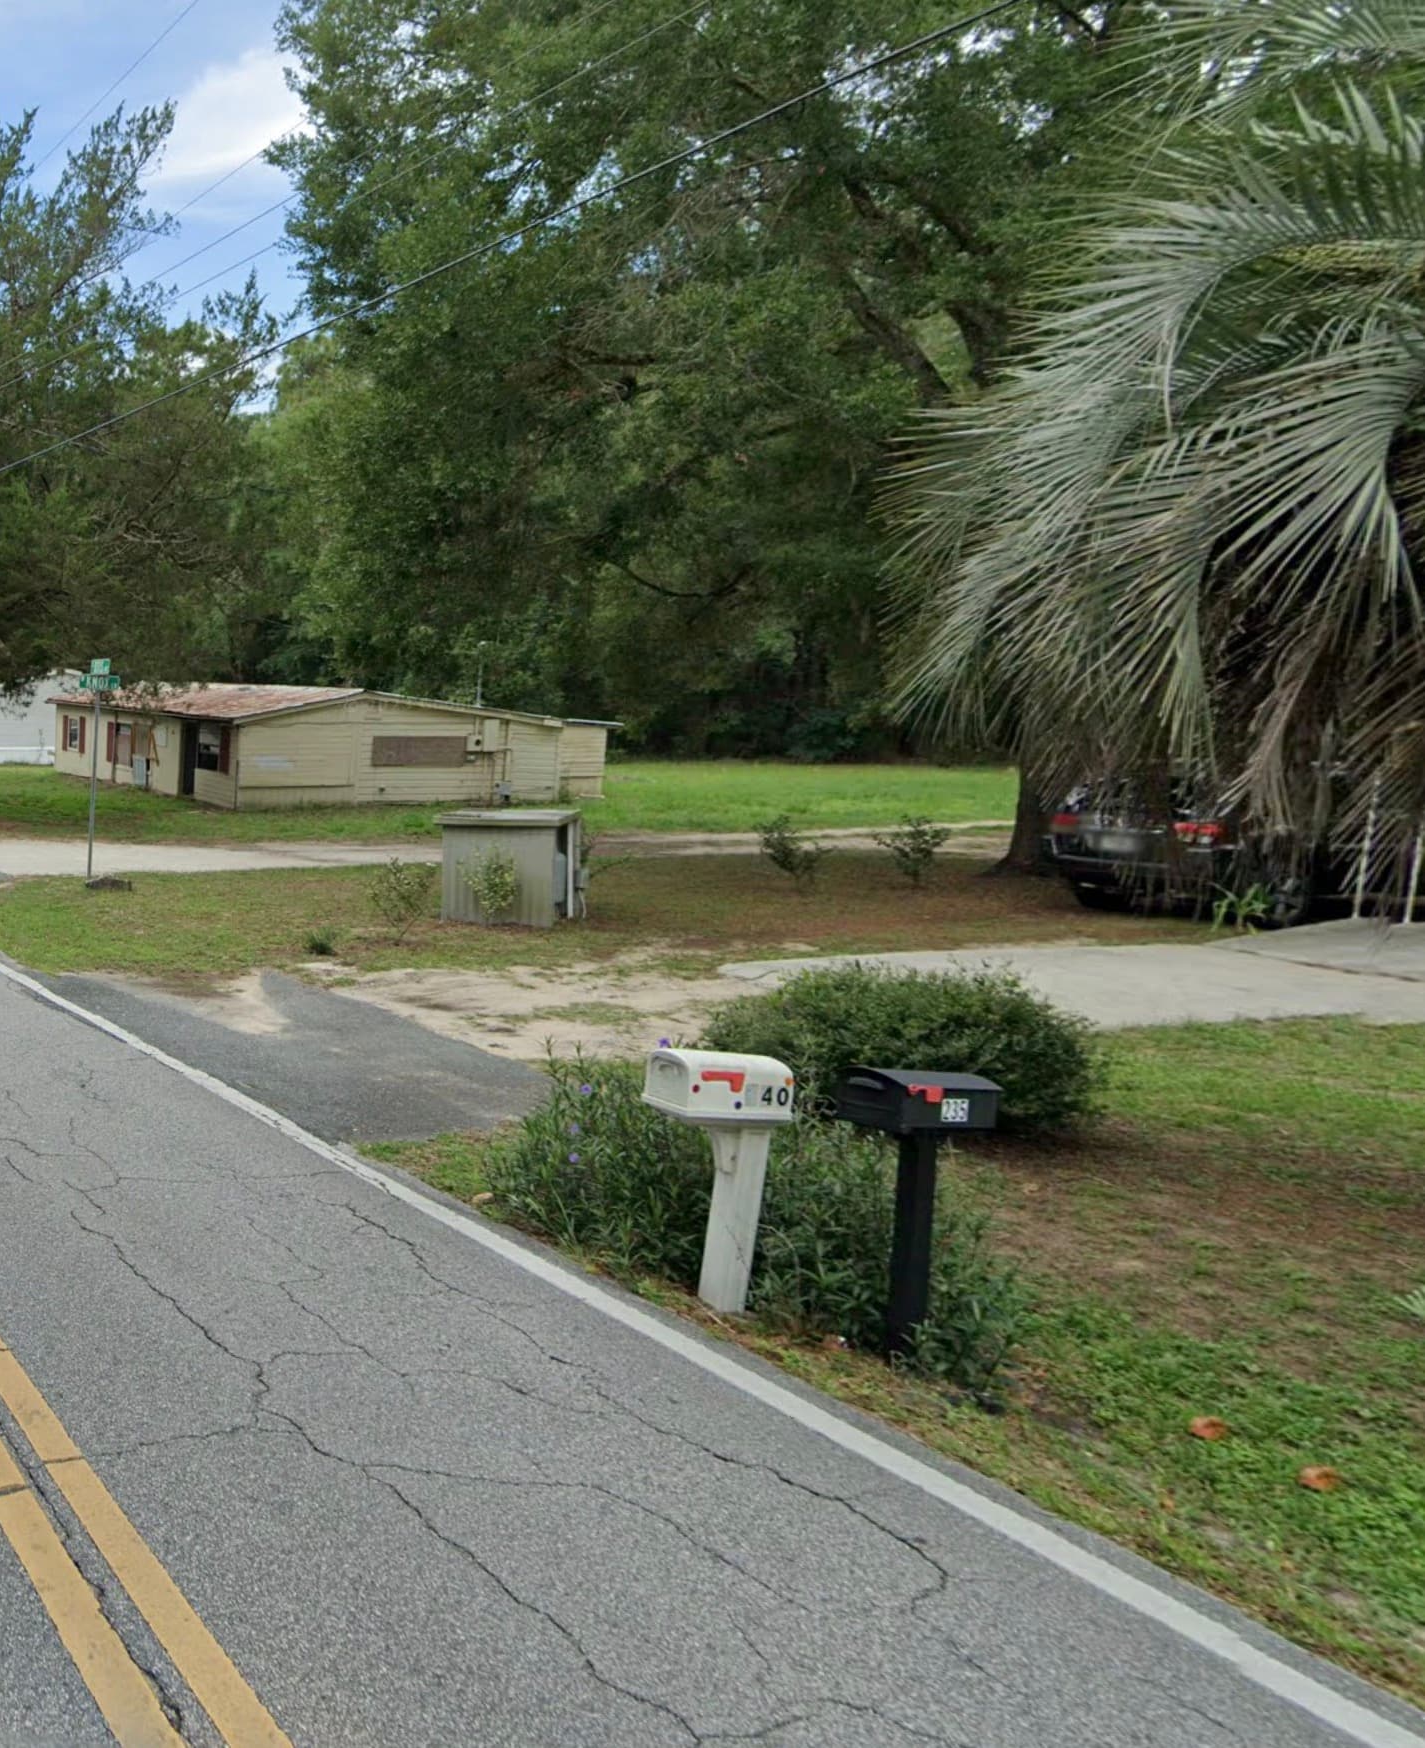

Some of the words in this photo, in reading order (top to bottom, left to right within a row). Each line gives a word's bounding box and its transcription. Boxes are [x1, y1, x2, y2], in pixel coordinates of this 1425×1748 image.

[86, 676, 109, 689] KNOX
[761, 1086, 789, 1106] 40
[942, 1100, 968, 1121] 235
